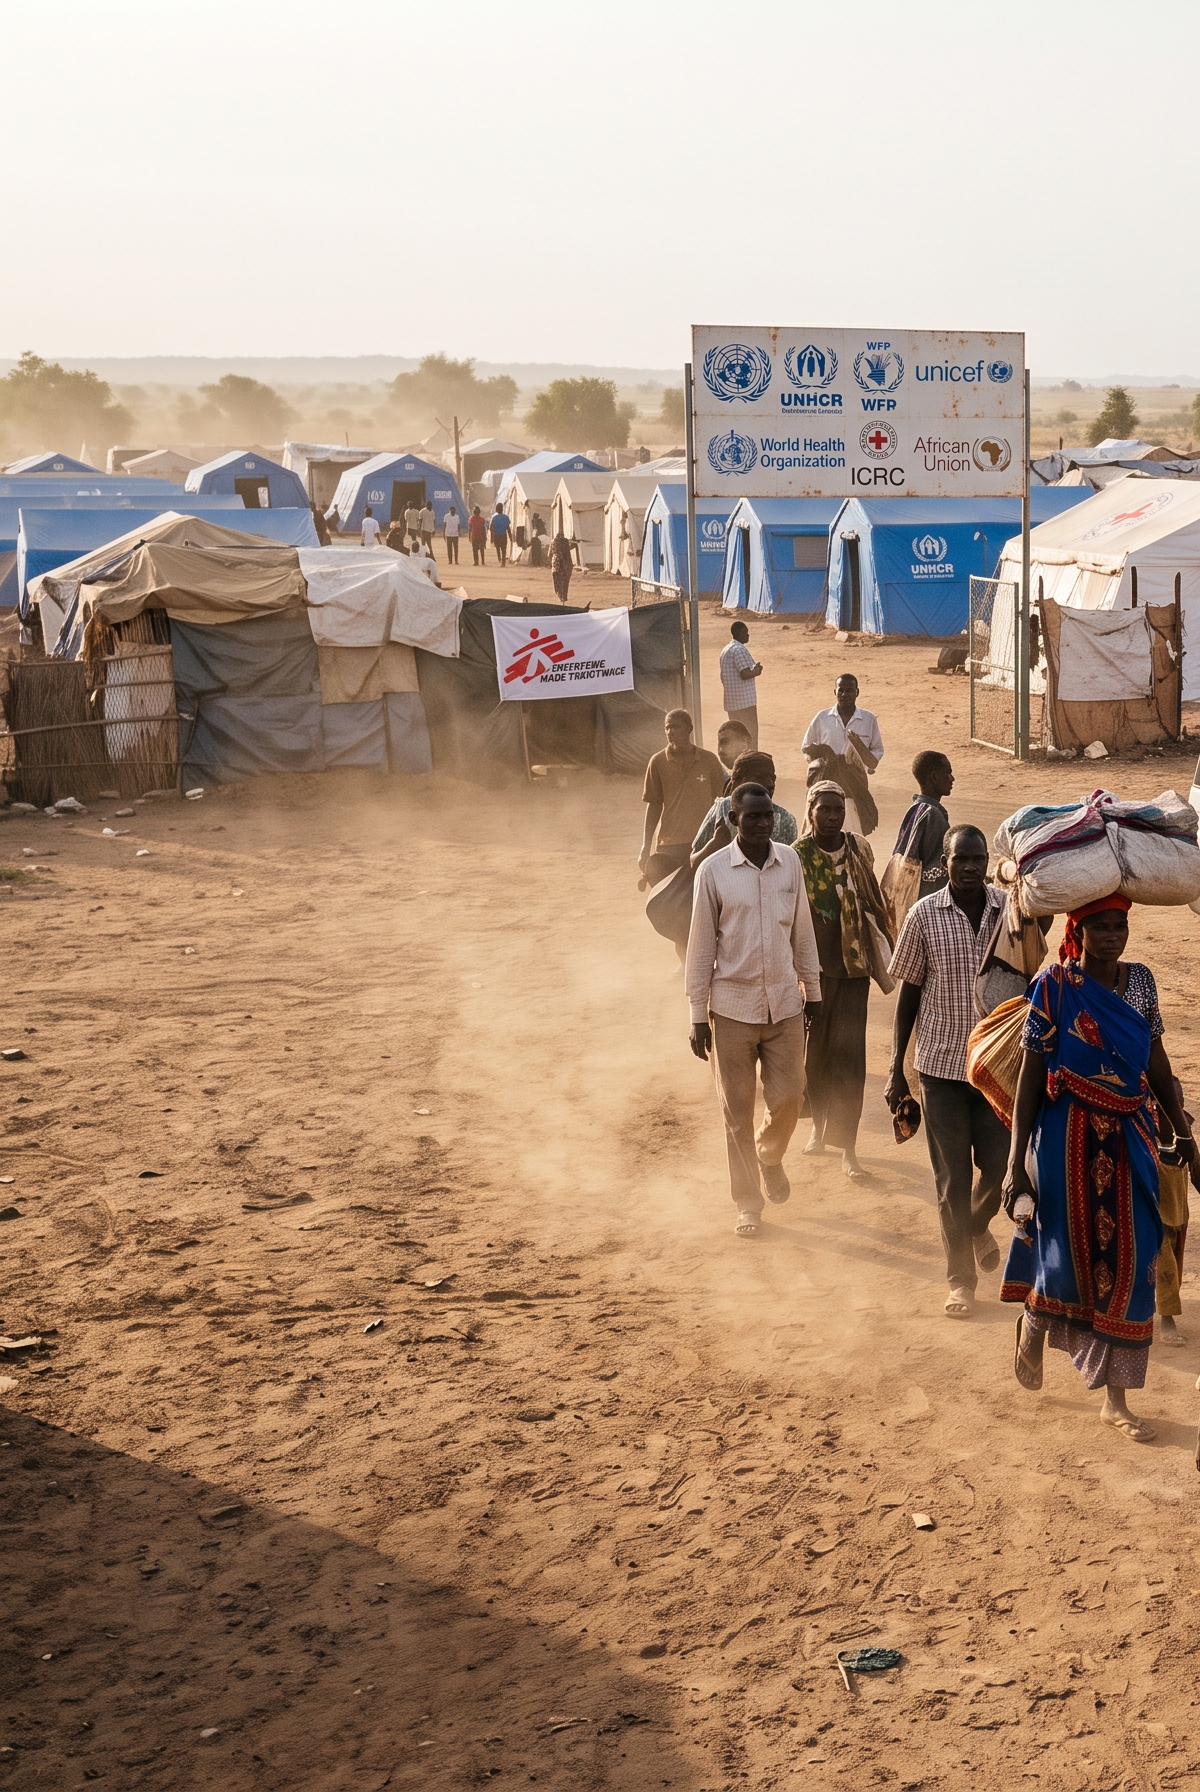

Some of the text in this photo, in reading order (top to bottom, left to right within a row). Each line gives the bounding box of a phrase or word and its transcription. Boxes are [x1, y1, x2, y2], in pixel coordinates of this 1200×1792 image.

[866, 342, 891, 350] WFP
[915, 359, 985, 382] unicef
[780, 393, 843, 407] UNHCR
[760, 437, 845, 451] World Health
[913, 437, 970, 453] African
[760, 454, 846, 471] Organization
[924, 455, 971, 471] Union
[851, 467, 905, 486] ICRC
[911, 563, 954, 574] UNHCR
[540, 672, 567, 683] MADE
